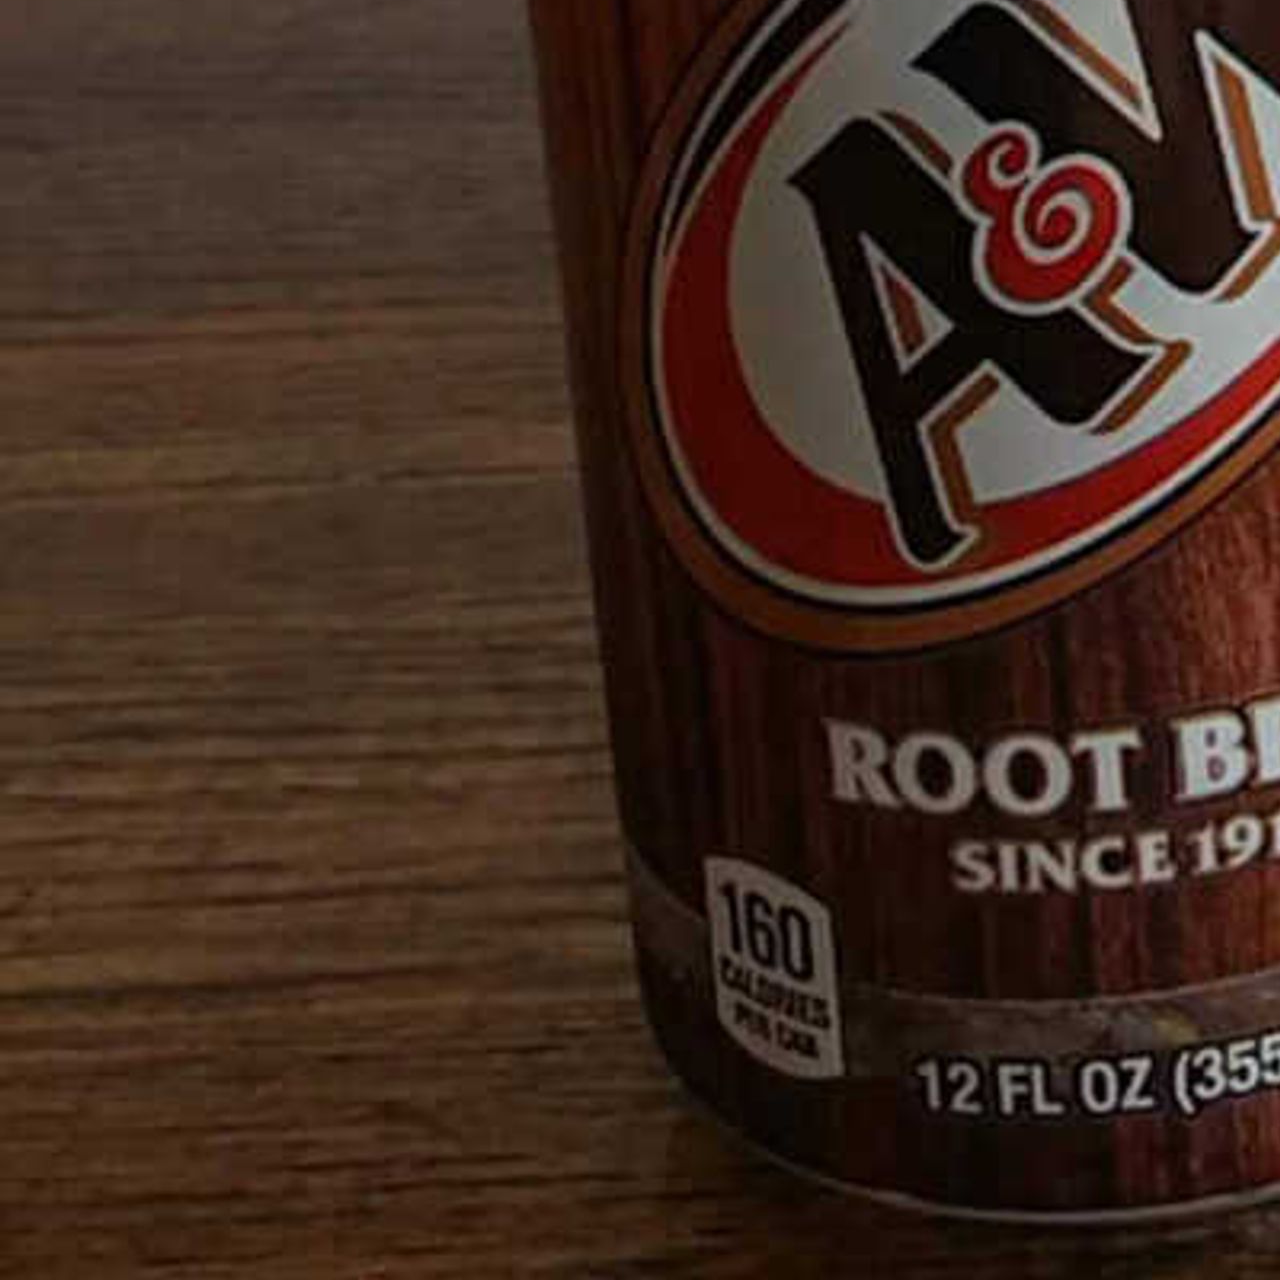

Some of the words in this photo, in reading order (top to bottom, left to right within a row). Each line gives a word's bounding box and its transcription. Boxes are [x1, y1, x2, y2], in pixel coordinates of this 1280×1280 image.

[825, 717, 1141, 815] ROOT
[949, 830, 1178, 892] SINCE
[718, 881, 815, 981] 160
[917, 1061, 982, 1113] 12
[998, 1064, 1064, 1114] FL
[1081, 1058, 1155, 1113] OZ
